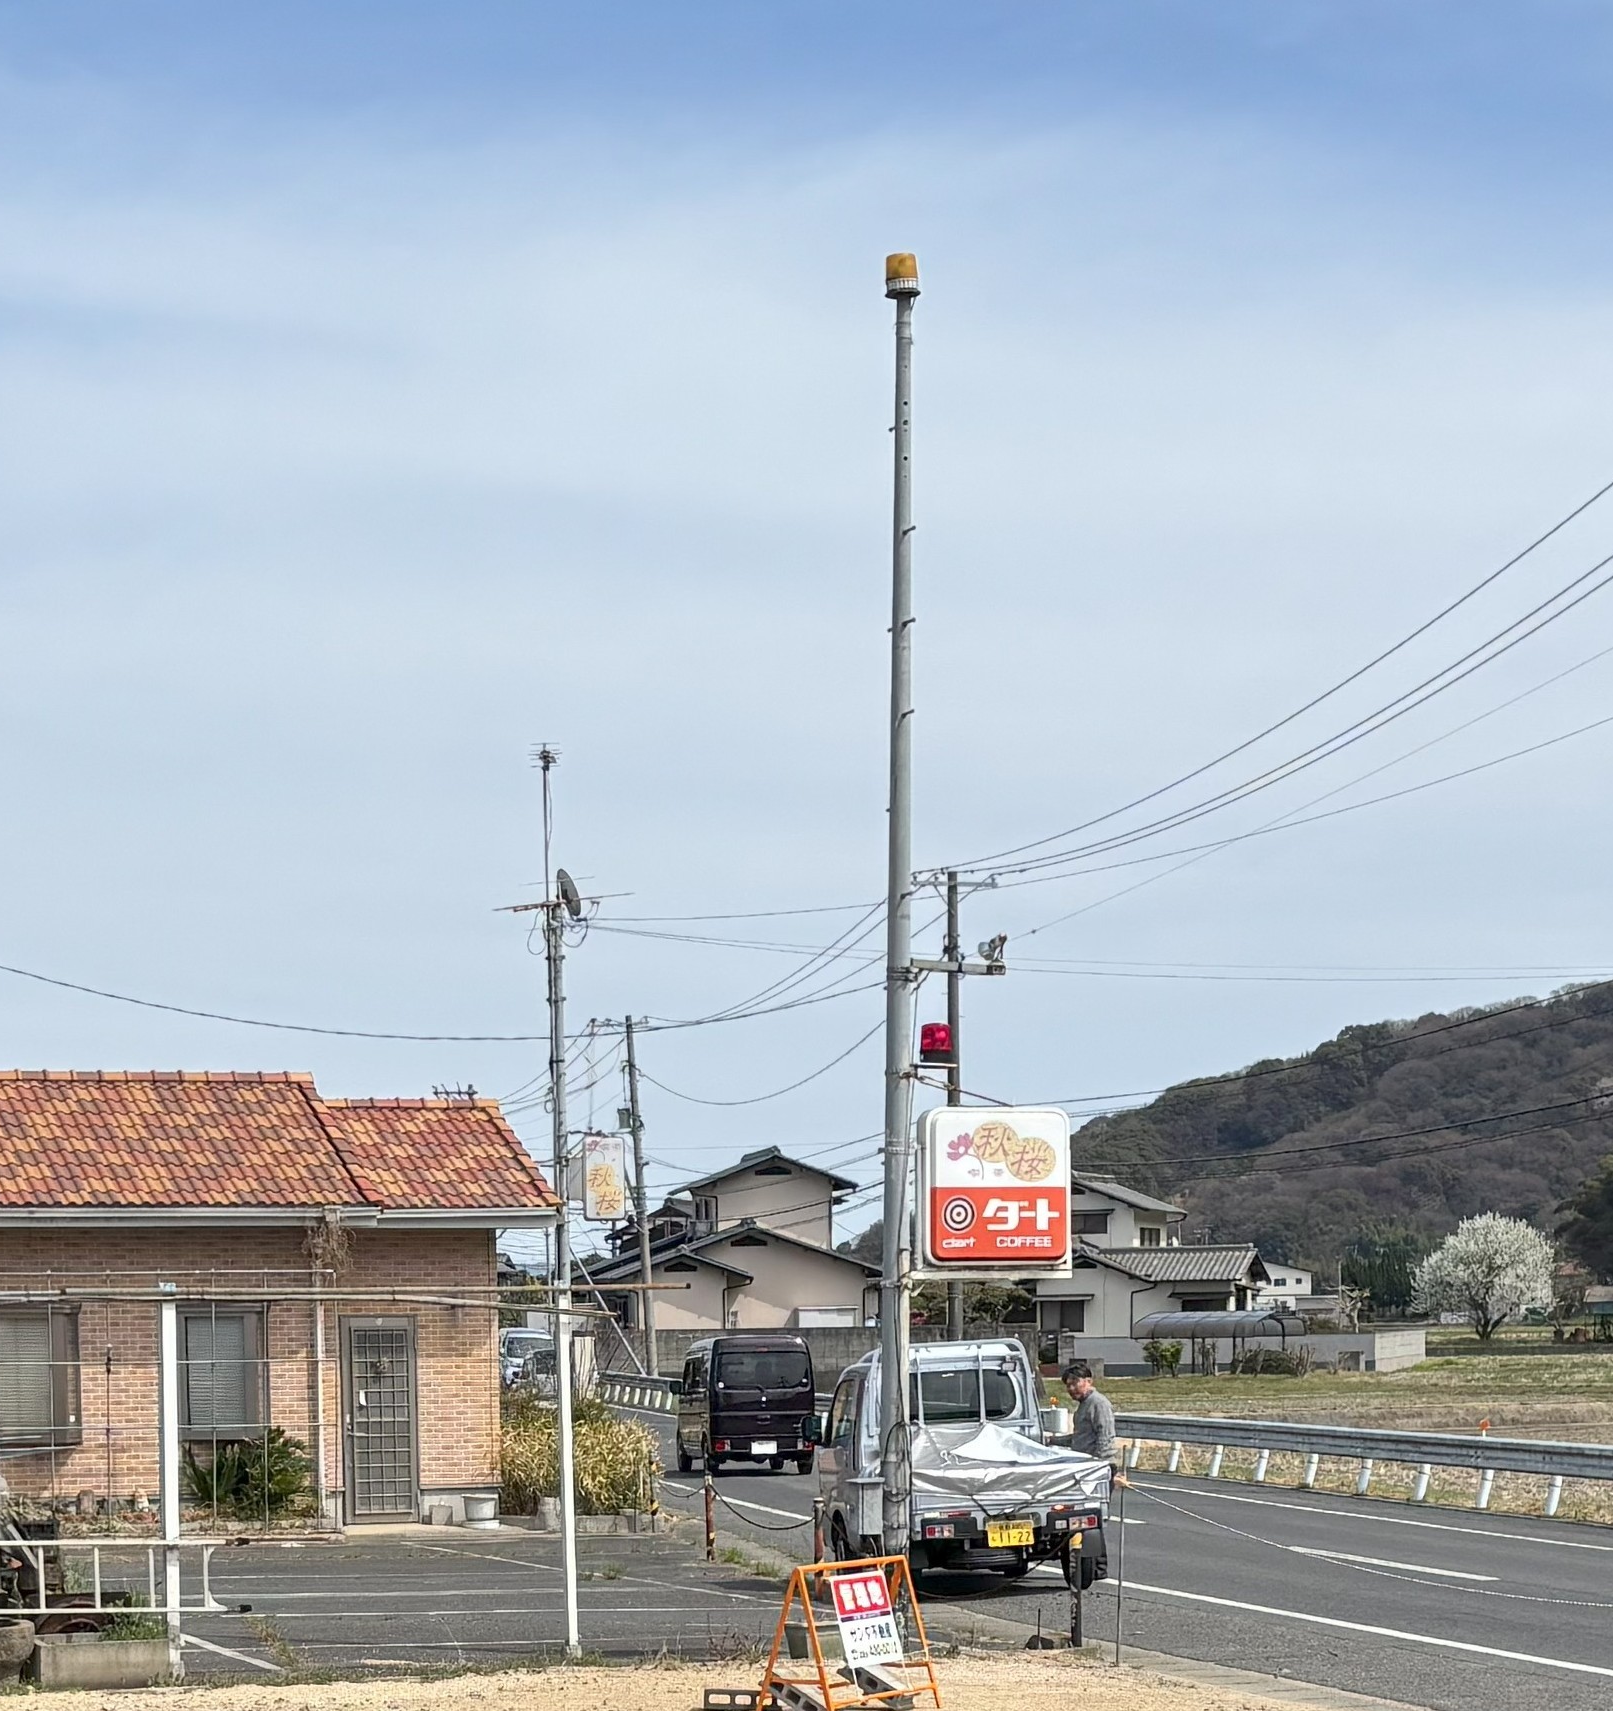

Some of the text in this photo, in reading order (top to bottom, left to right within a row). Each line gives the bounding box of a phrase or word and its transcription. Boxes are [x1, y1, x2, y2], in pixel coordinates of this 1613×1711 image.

[975, 1125, 1049, 1175] 秋桜
[588, 1166, 622, 1211] 秋桜
[982, 1198, 1060, 1231] ダート
[996, 1235, 1052, 1248] COFFEE
